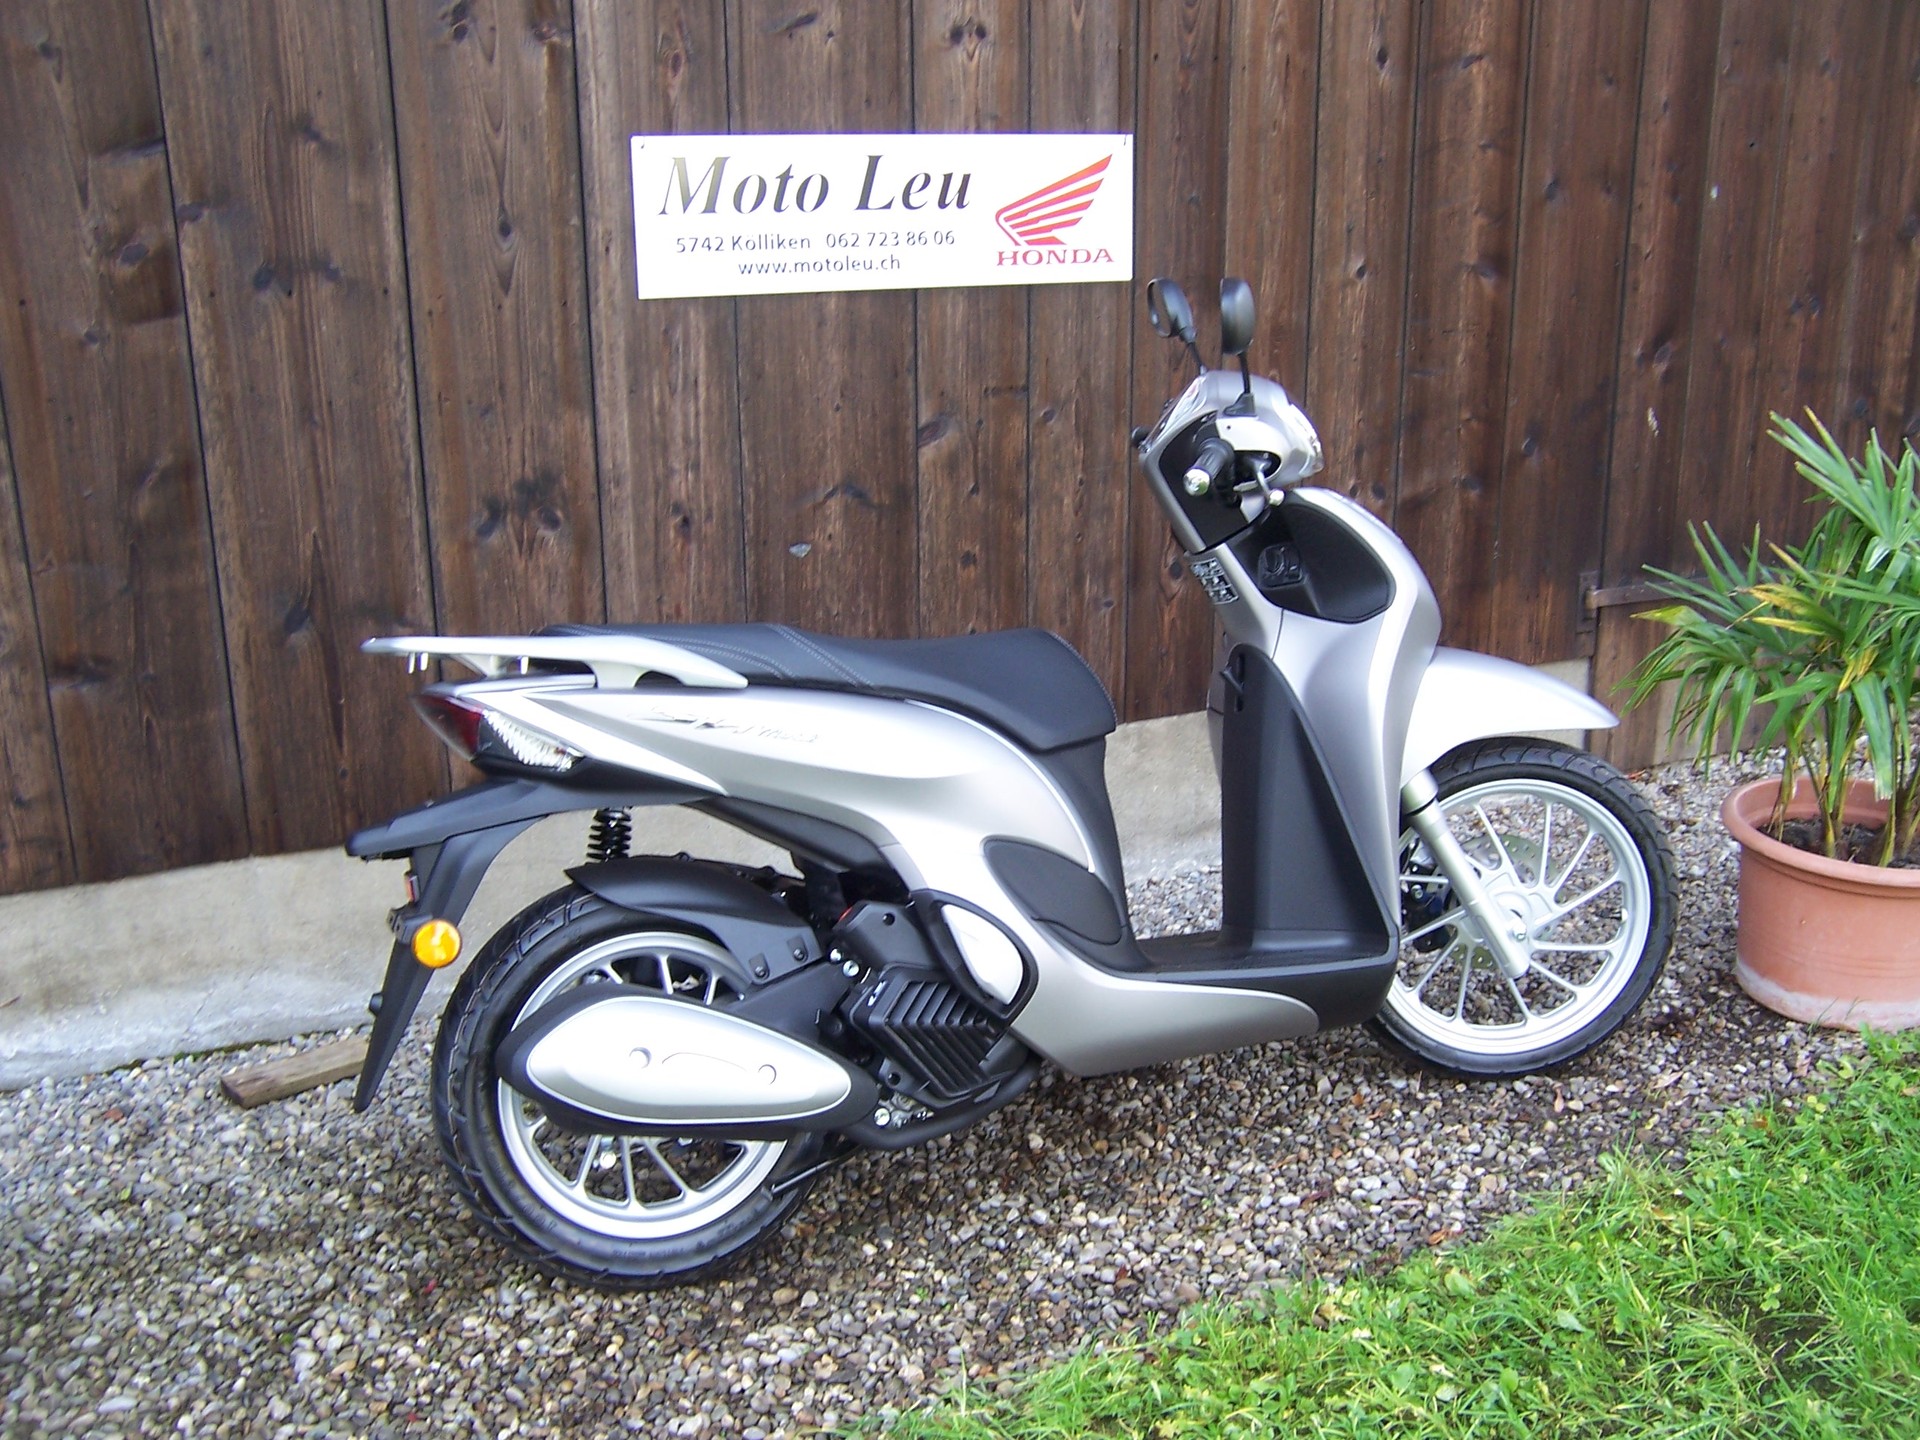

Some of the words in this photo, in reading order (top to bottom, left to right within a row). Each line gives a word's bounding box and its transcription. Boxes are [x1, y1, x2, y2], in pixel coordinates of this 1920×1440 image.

[658, 155, 830, 216] Moto
[853, 154, 972, 211] Leu
[676, 236, 725, 254] 5742
[825, 232, 860, 249] 062
[866, 231, 900, 248] 723
[906, 230, 928, 247] 86
[933, 230, 955, 246] 06
[738, 253, 901, 275] www.motoleu.ch
[996, 247, 1115, 267] HONDA
